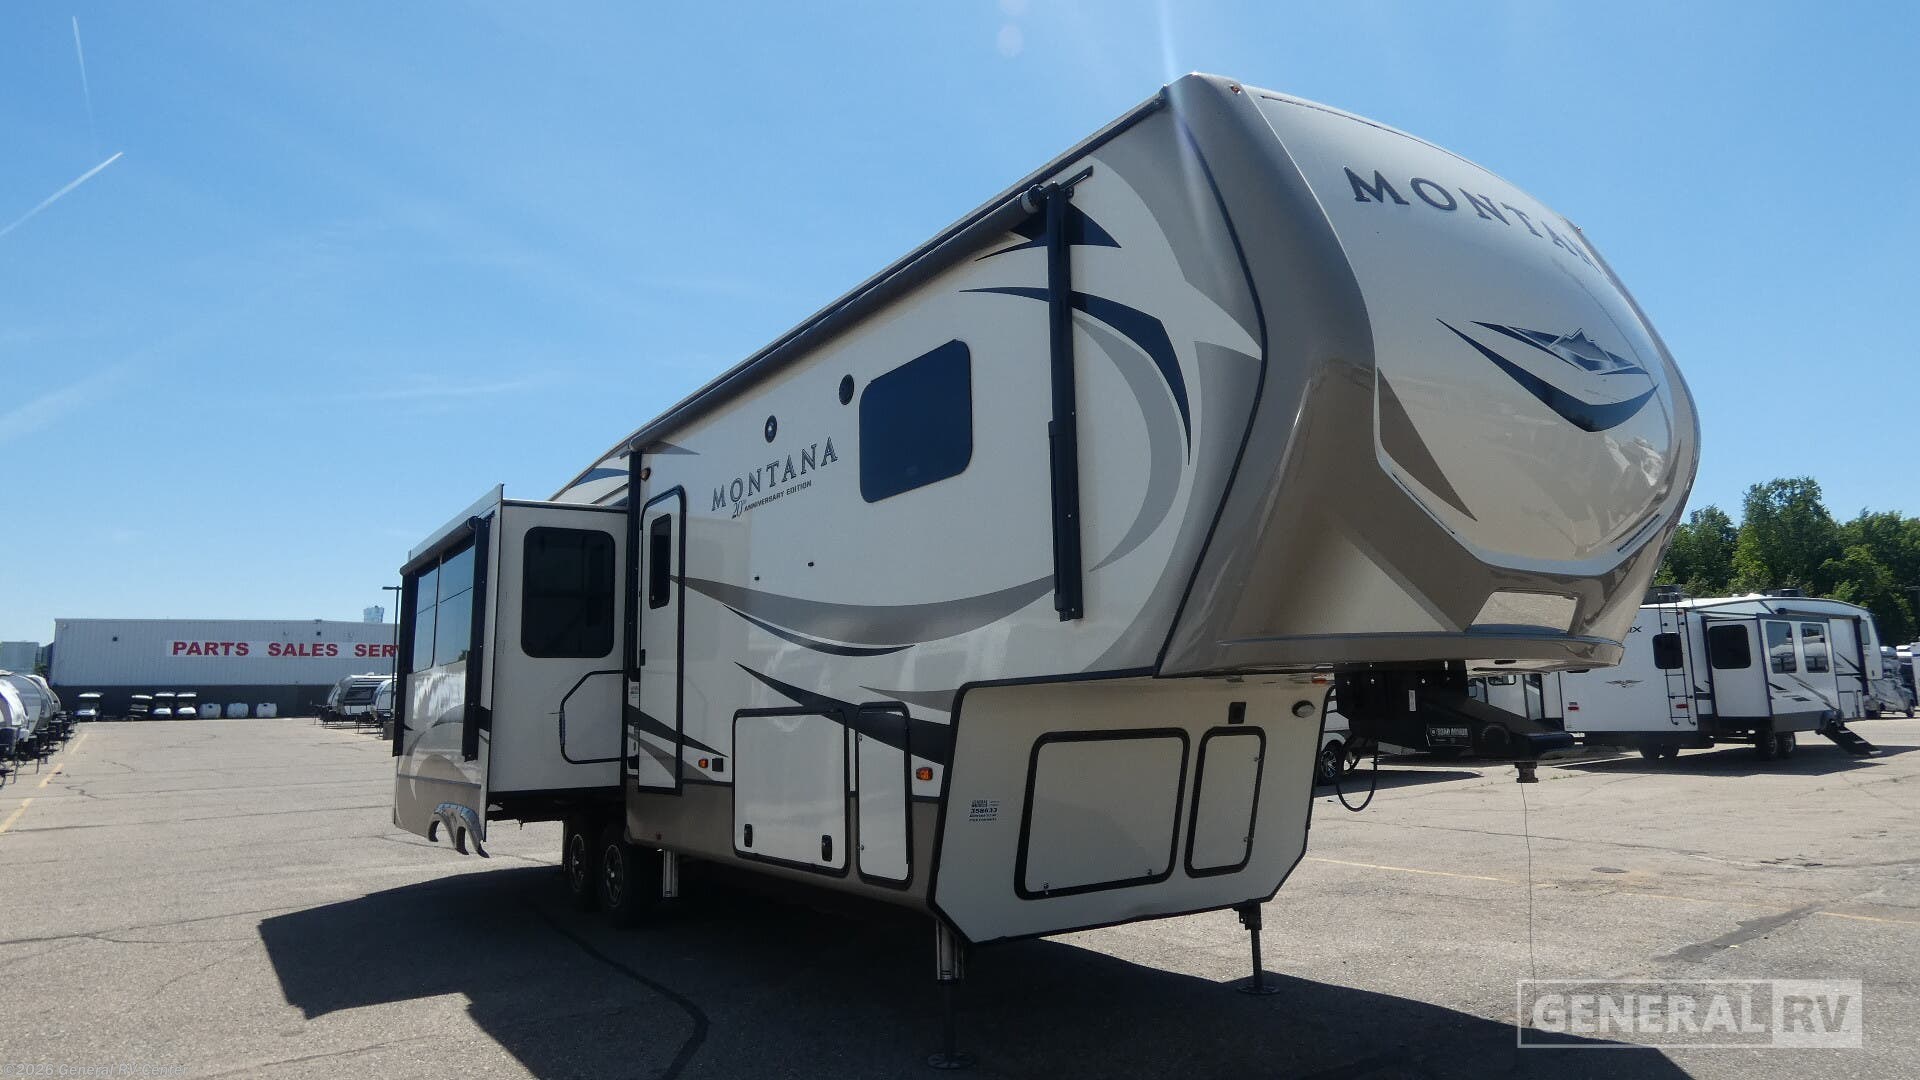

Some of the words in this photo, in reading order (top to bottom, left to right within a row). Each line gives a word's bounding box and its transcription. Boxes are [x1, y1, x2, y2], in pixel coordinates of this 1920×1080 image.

[1343, 165, 1602, 274] MONTAN
[711, 435, 838, 512] MONTANA
[744, 490, 785, 512] ANNIVERSARY
[786, 479, 812, 496] EDITION
[172, 641, 250, 656] PARTS
[268, 643, 338, 657] SALES
